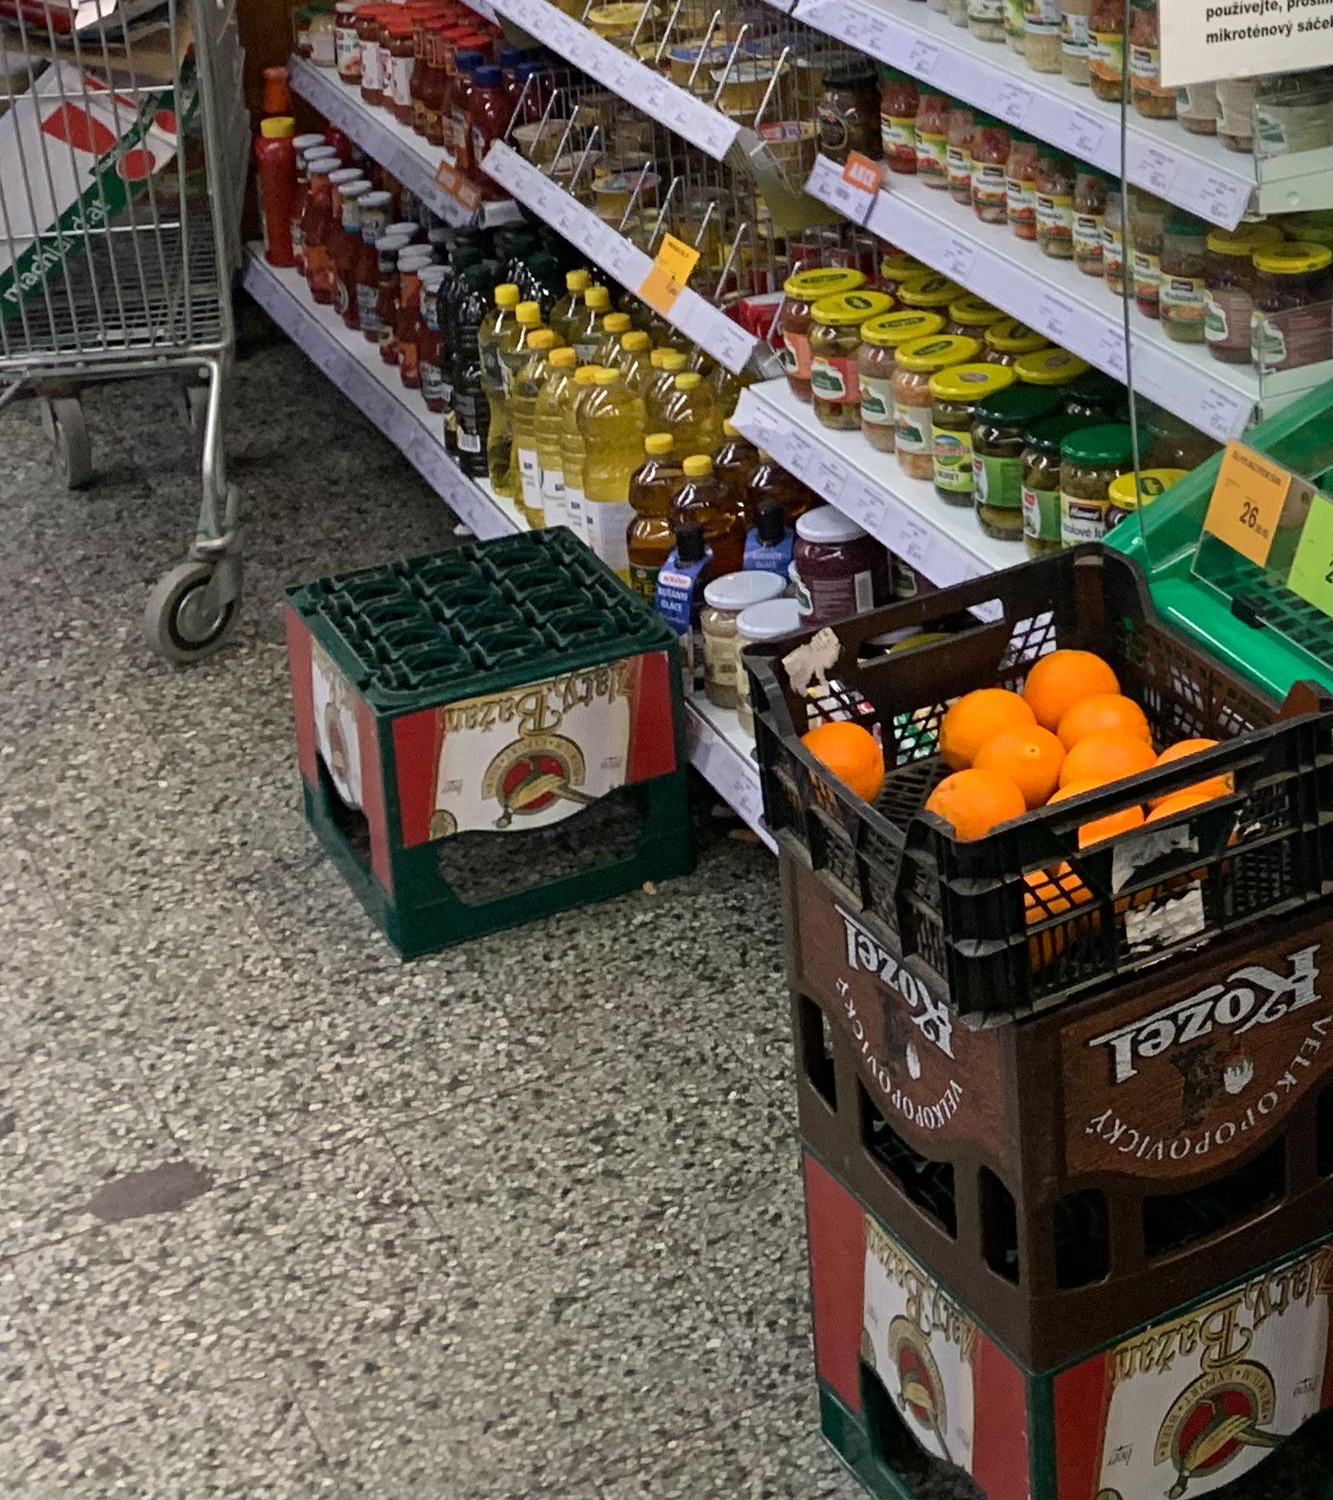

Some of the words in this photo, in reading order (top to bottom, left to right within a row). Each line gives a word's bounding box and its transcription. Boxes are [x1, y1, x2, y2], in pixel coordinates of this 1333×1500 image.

[1206, 0, 1283, 22] používejte,
[1206, 20, 1293, 45] mikroténový
[834, 904, 955, 1059] Kozel
[1089, 944, 1321, 1083] Kozel
